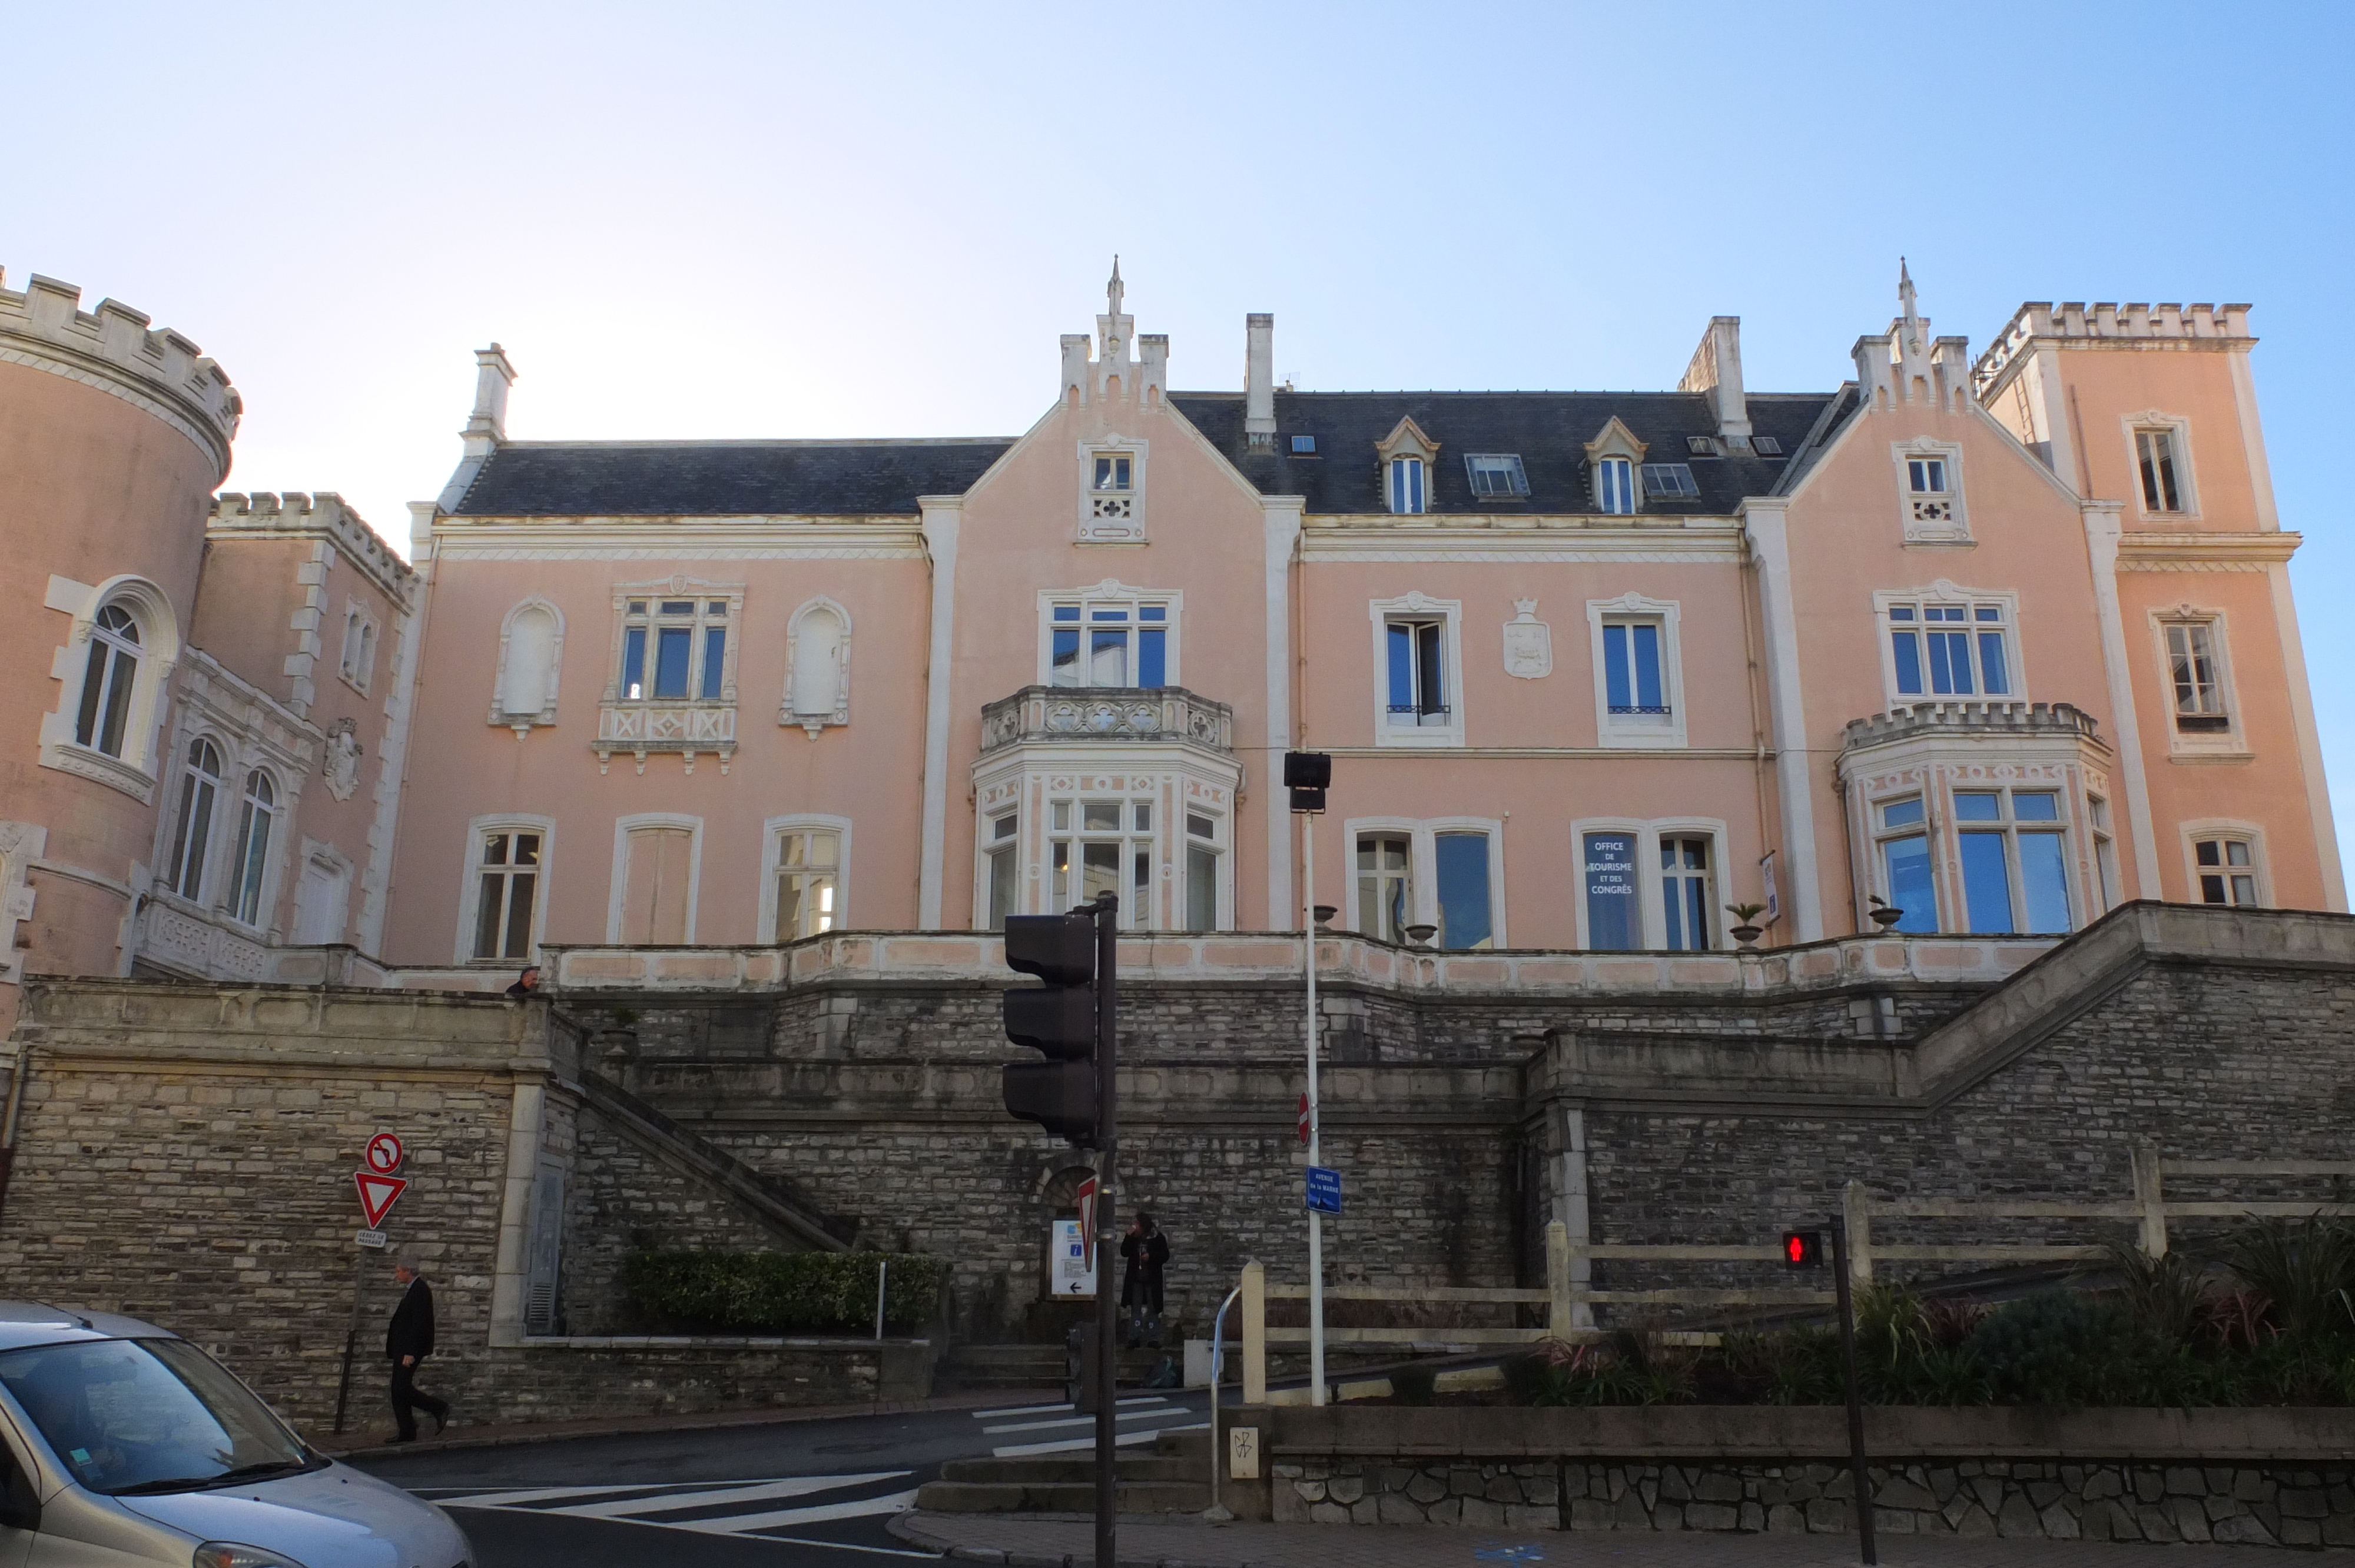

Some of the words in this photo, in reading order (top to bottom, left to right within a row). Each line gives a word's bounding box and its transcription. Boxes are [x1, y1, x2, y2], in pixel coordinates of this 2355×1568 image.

[1595, 842, 1624, 851] OFFICE
[1590, 863, 1632, 871] TOURISME
[1591, 884, 1632, 894] CONGRÈS
